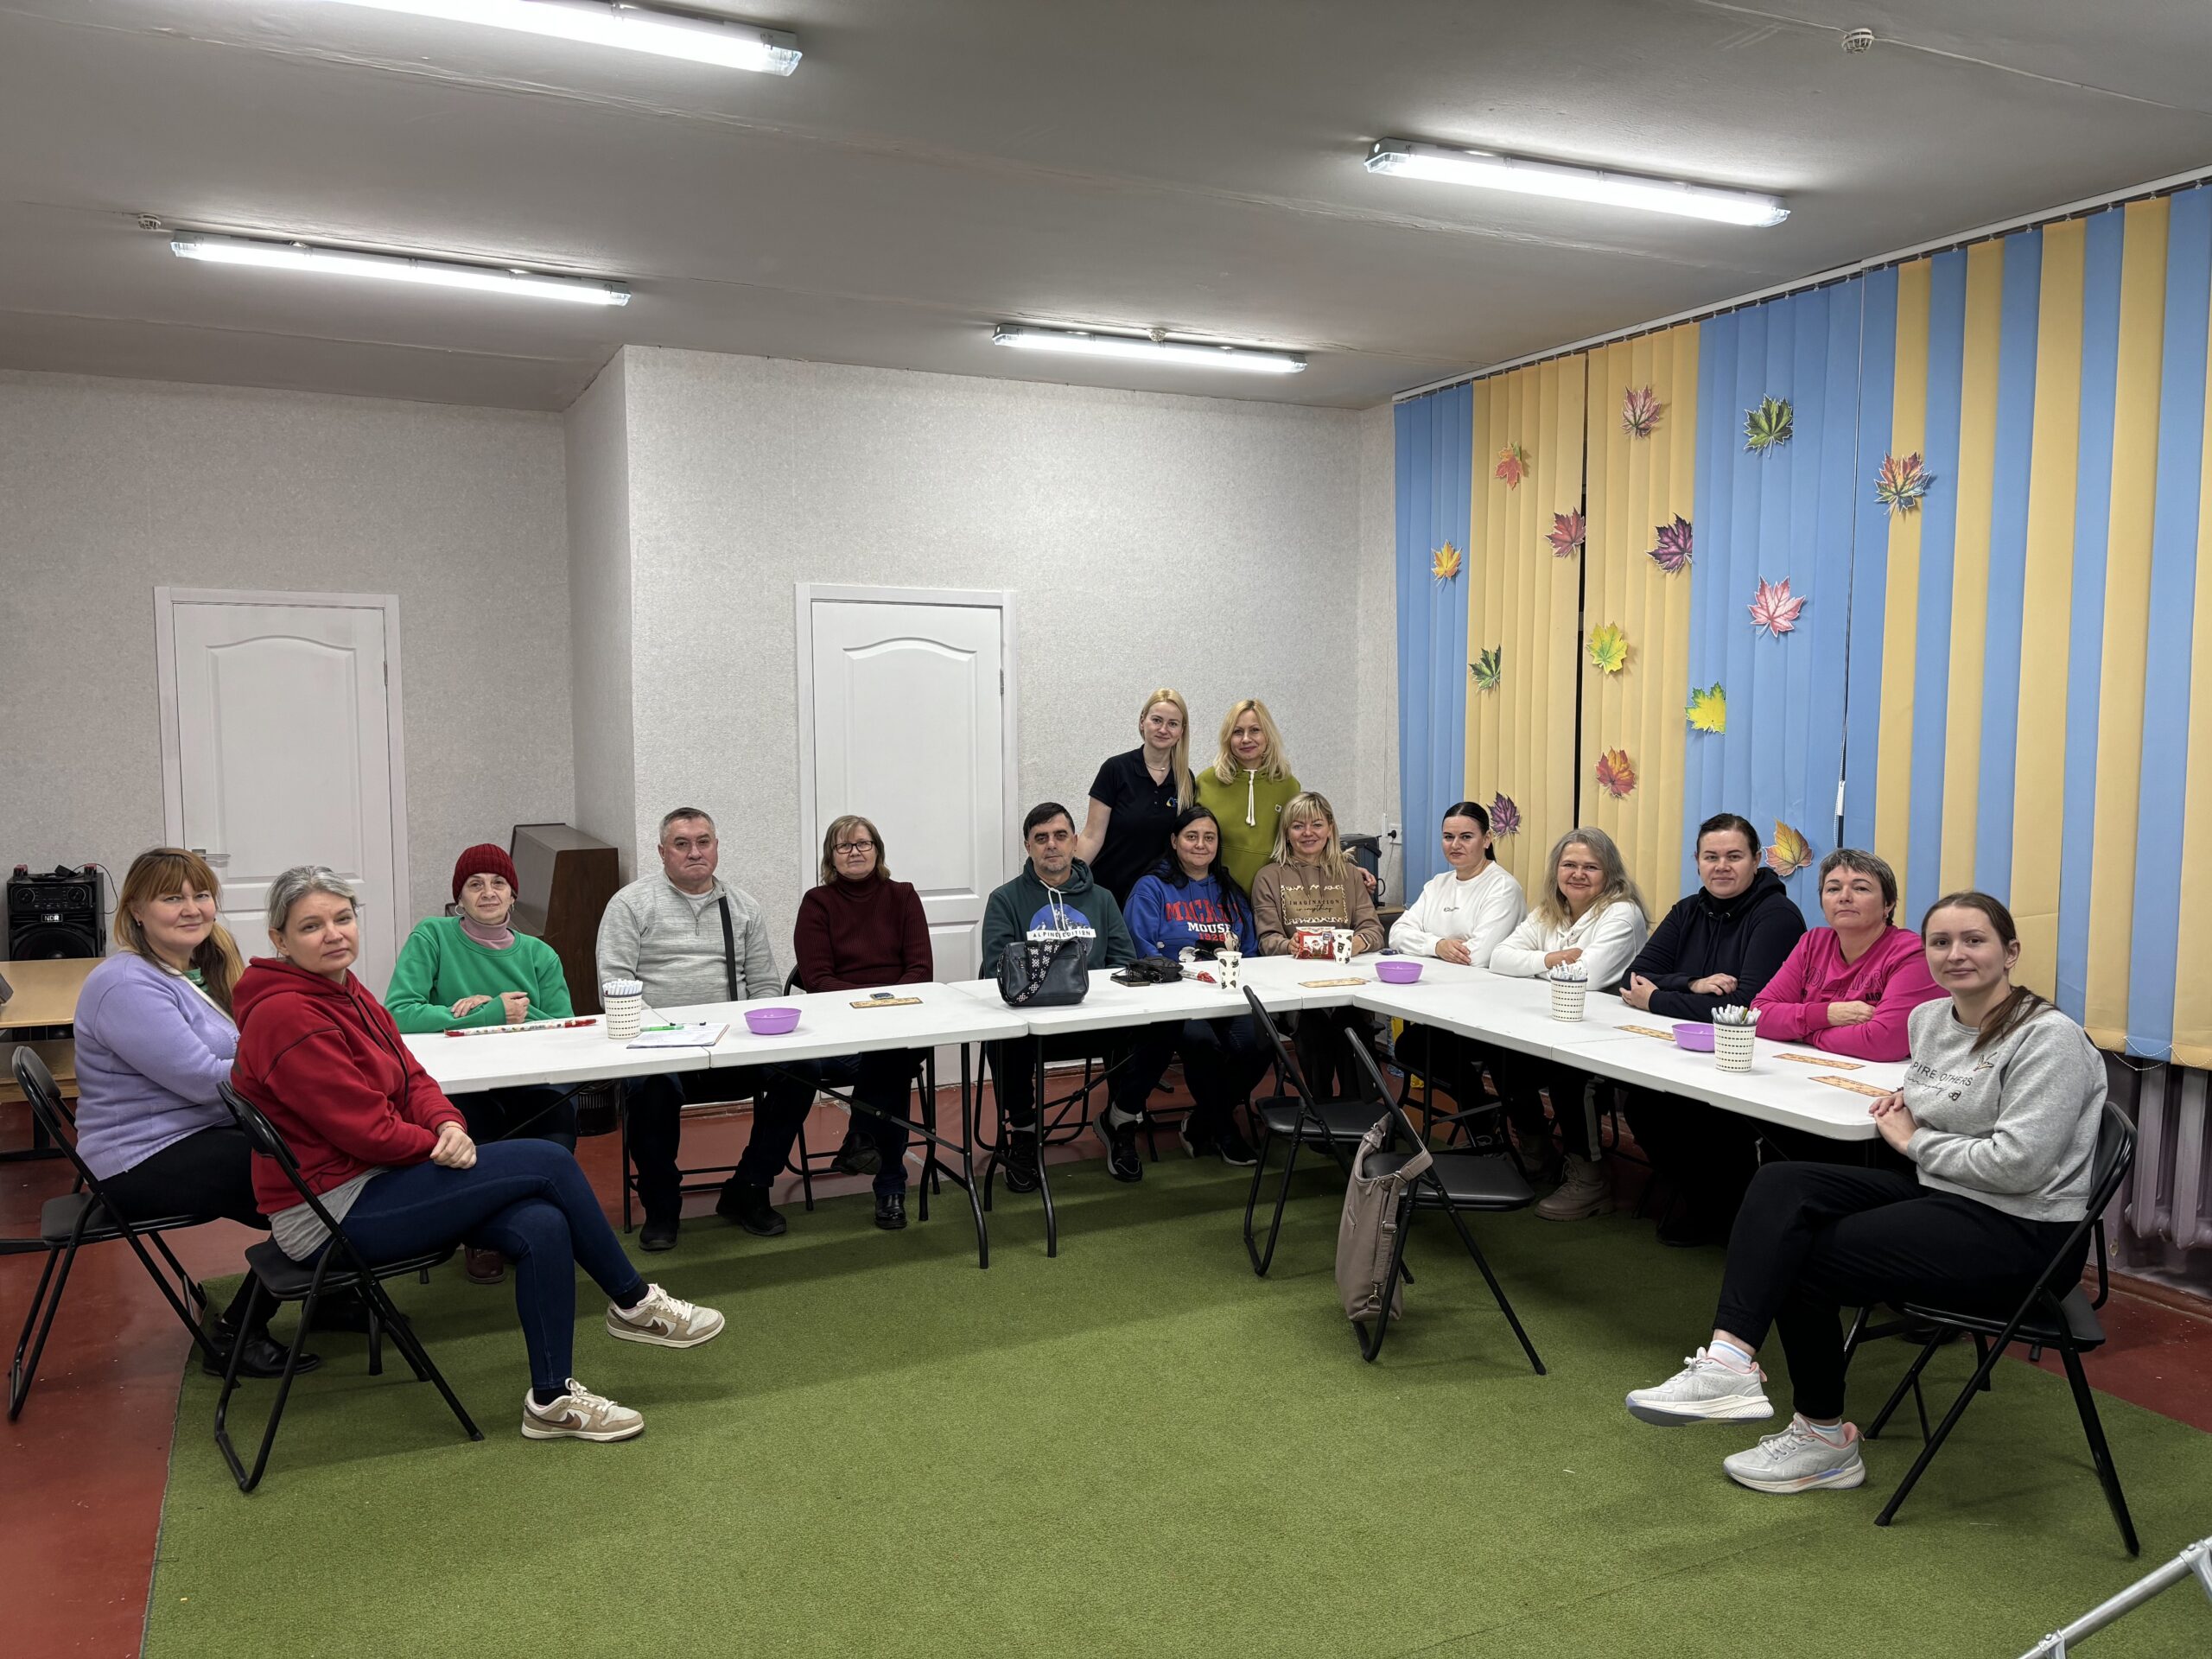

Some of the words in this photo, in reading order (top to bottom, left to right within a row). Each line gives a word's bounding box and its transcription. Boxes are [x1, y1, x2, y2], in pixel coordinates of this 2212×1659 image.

[1187, 921, 1231, 933] MOUSE
[1198, 933, 1226, 942] 1928
[1939, 1073, 1974, 1087] OTHERS
